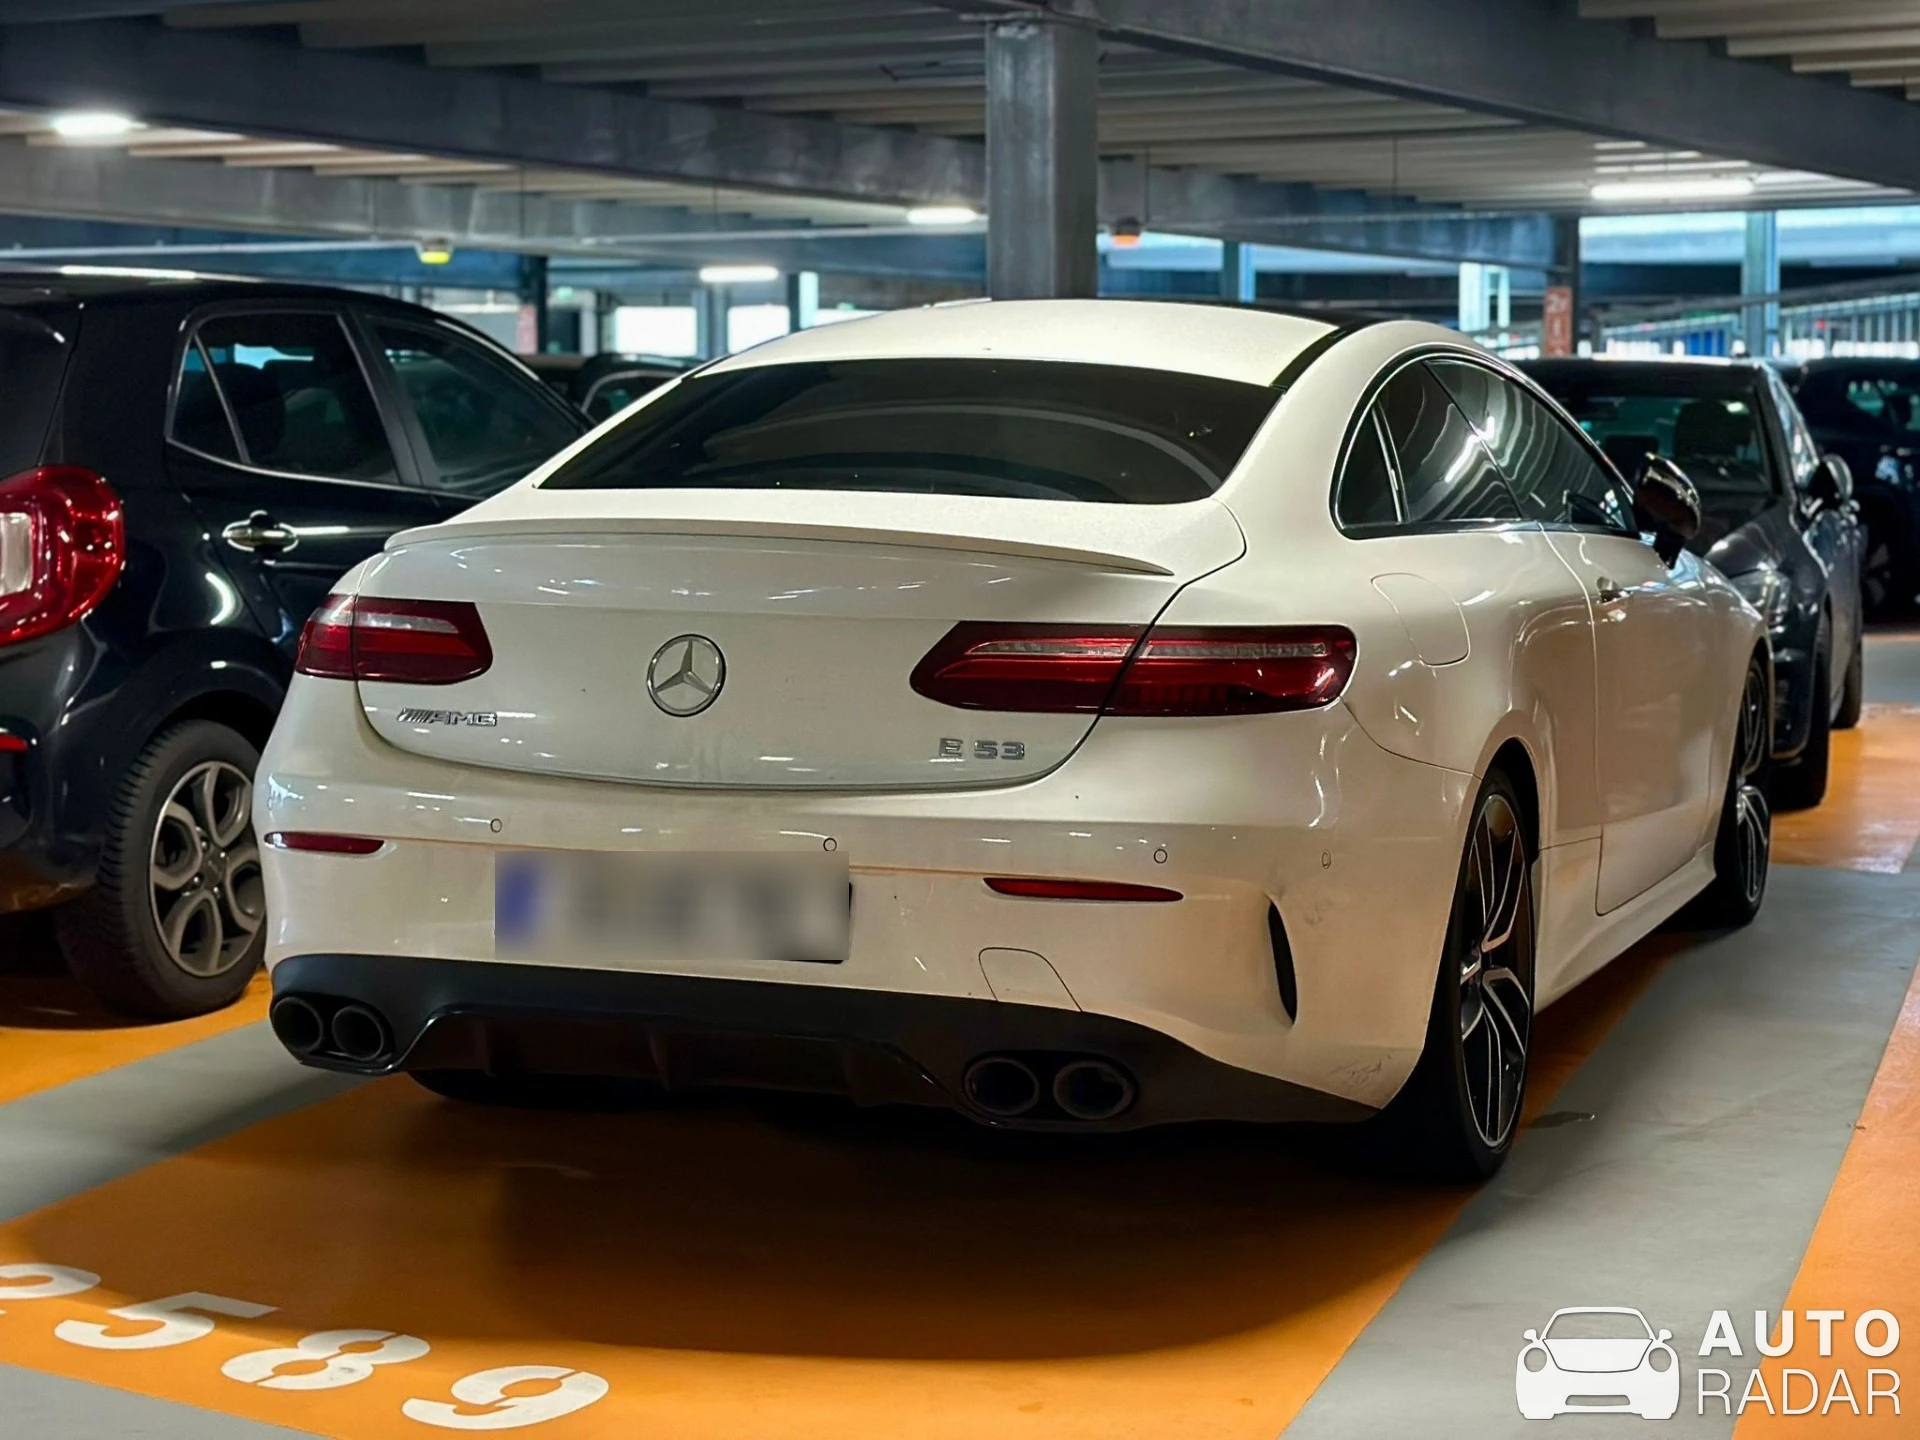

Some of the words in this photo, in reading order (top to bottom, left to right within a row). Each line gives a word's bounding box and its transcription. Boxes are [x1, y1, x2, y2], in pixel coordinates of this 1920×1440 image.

[426, 709, 497, 727] AMG
[939, 738, 963, 757] E
[974, 740, 1025, 760] 53
